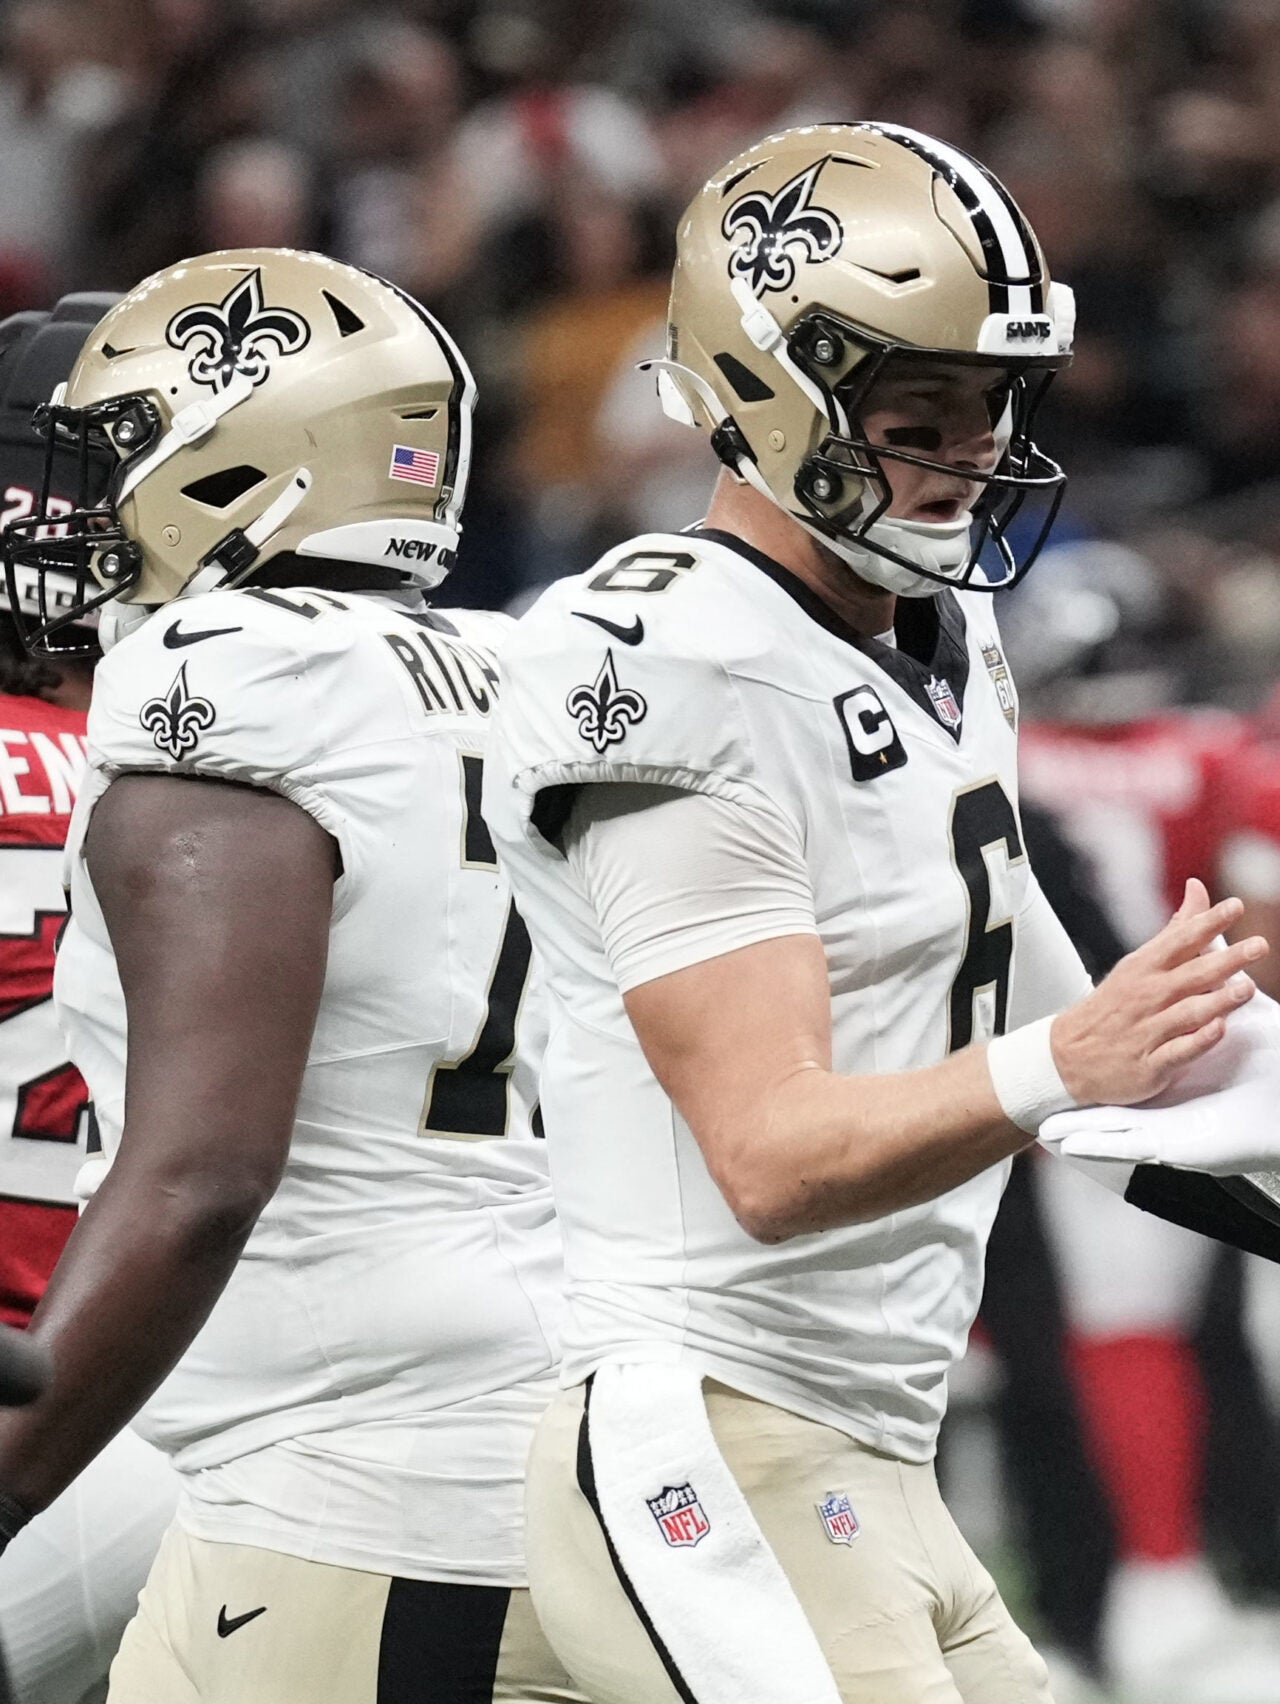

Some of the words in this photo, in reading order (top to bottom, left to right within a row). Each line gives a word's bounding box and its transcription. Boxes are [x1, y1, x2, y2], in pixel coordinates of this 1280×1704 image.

[1006, 321, 1051, 339] SAINTS
[586, 549, 698, 597] 6
[842, 692, 894, 755] C
[946, 773, 1028, 1056] 6
[662, 1507, 707, 1542] NFL
[829, 1513, 856, 1536] NFL
